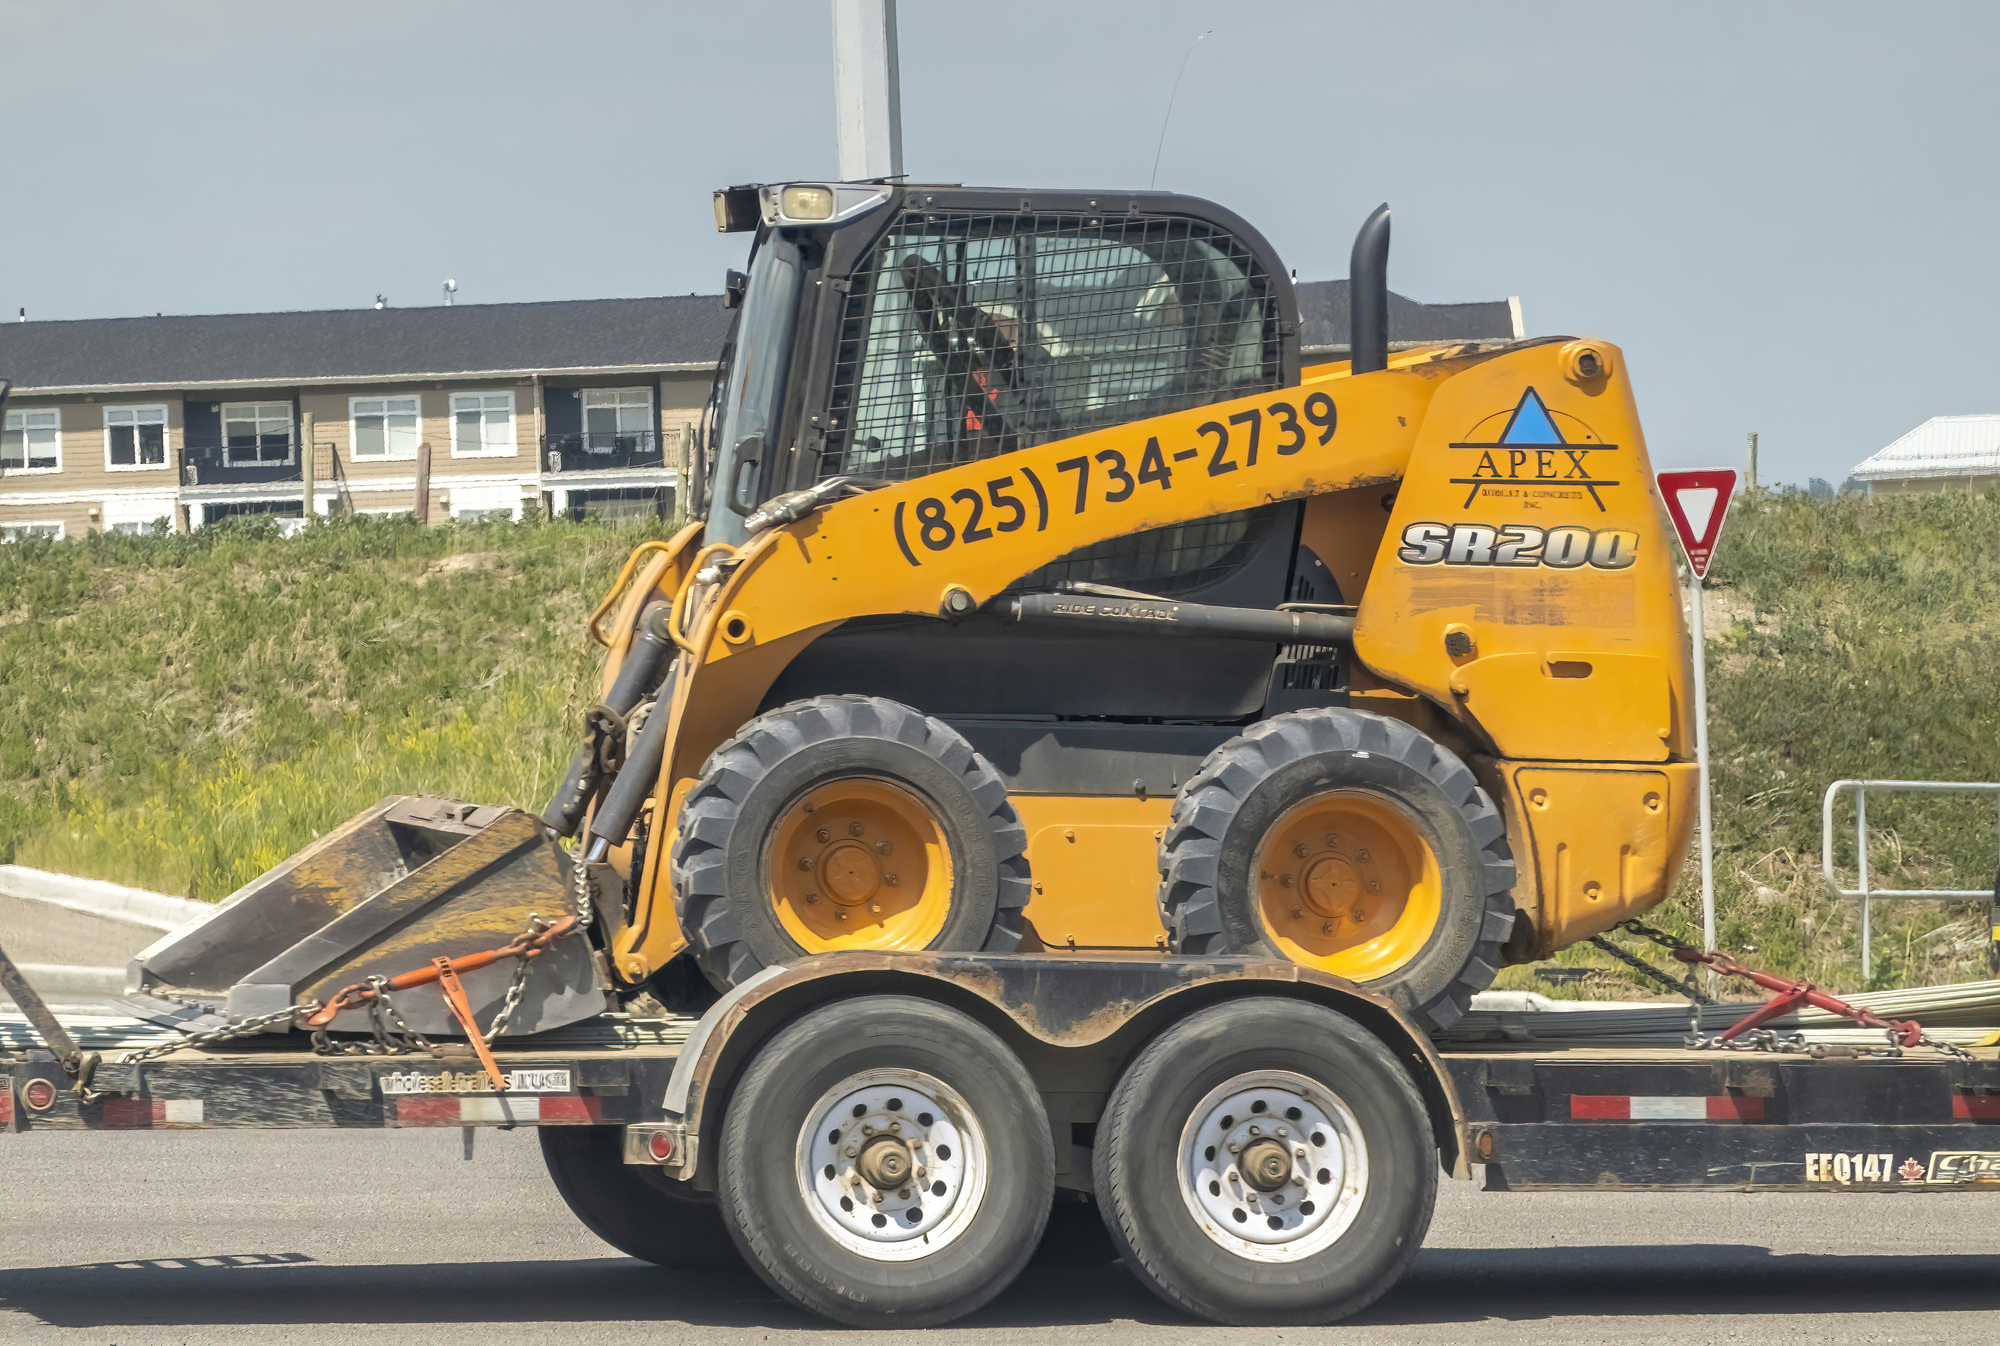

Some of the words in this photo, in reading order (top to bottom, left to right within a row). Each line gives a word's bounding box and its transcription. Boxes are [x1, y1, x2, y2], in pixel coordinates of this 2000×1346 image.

[894, 467, 1049, 566] (825)
[1056, 391, 1338, 515] 734-2739
[1472, 450, 1592, 480] APEX
[1397, 521, 1640, 570] SR200
[1805, 1152, 1894, 1186] EEQ147
